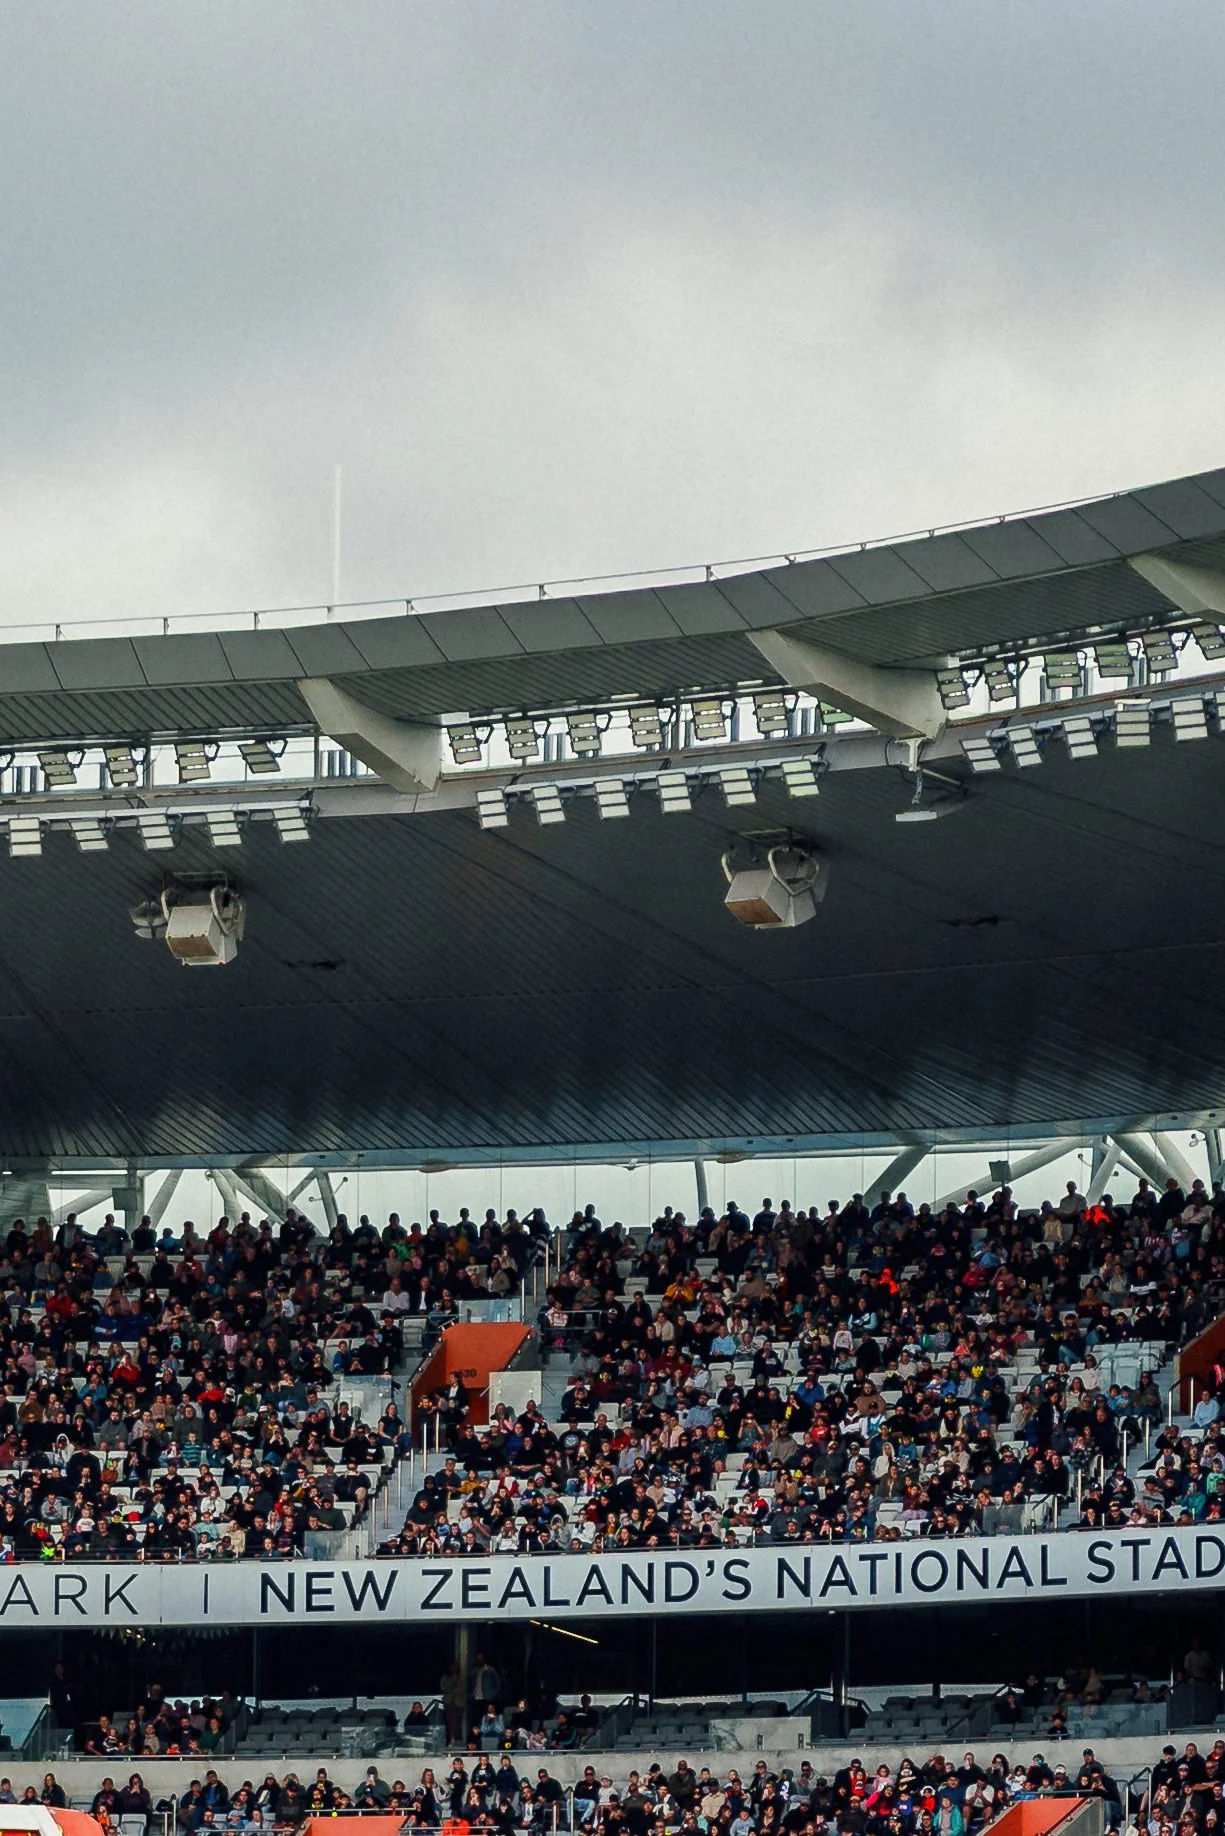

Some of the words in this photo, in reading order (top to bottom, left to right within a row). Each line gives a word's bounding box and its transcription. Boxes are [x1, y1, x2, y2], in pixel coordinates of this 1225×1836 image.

[260, 1569, 398, 1613] NEW
[420, 1558, 752, 1610] ZEALAND'S
[777, 1544, 1068, 1598] NATIONAL
